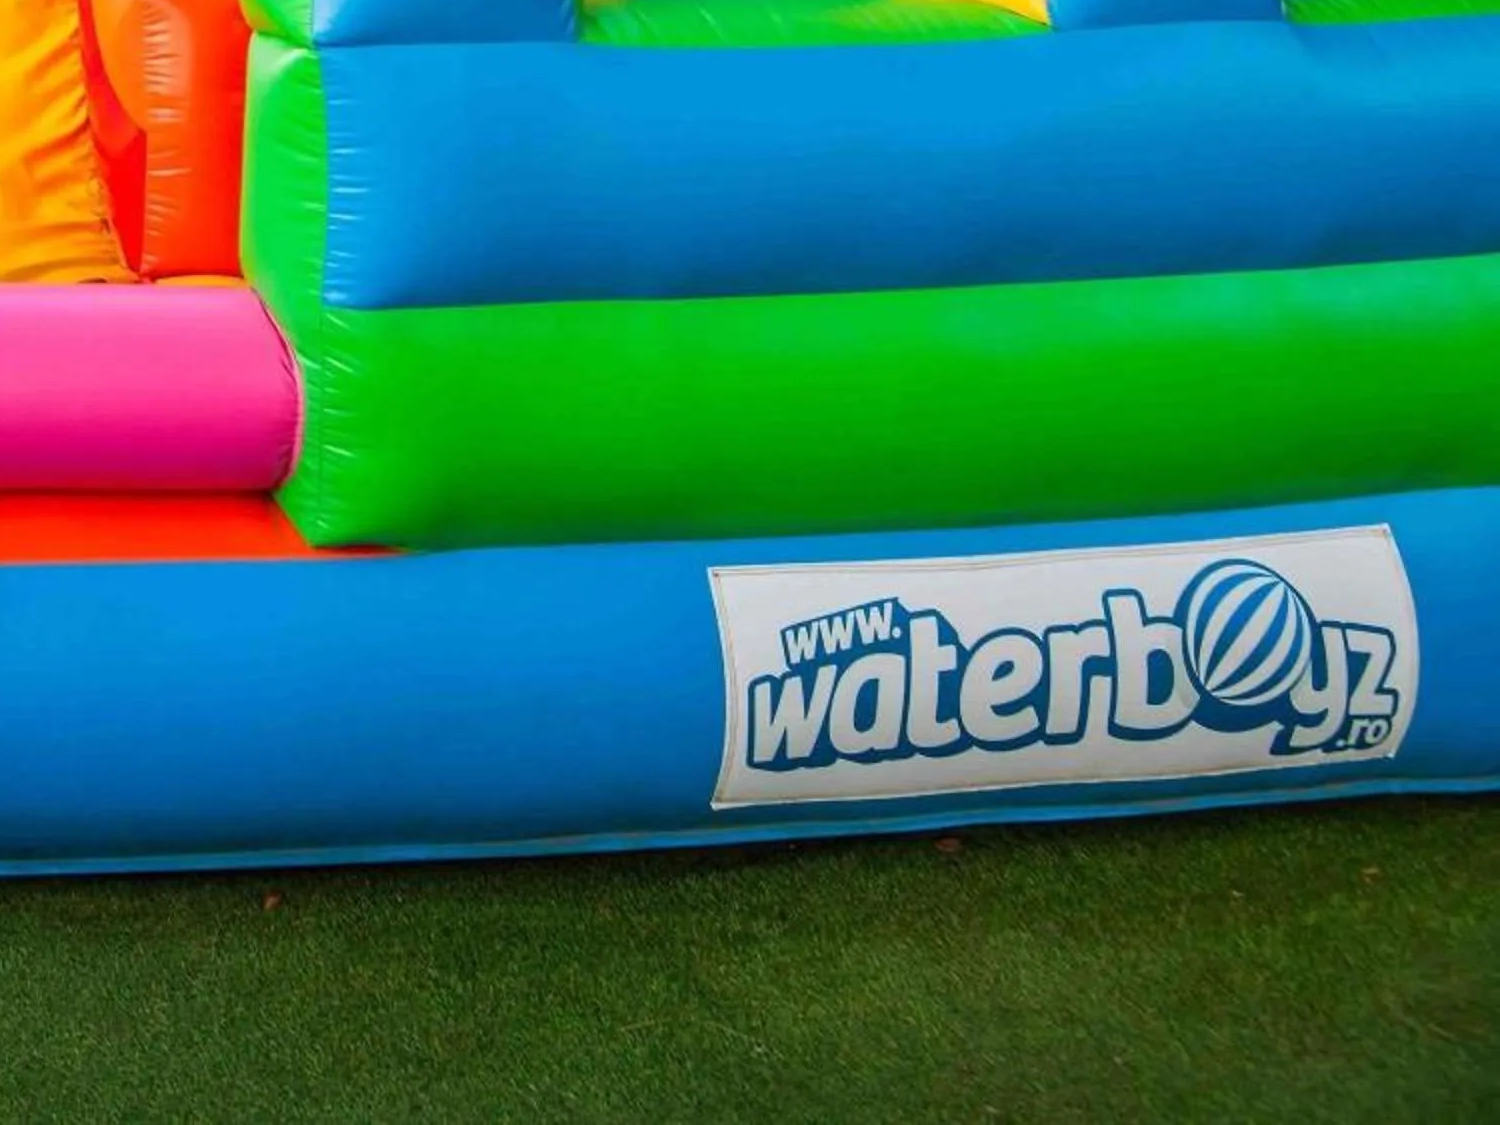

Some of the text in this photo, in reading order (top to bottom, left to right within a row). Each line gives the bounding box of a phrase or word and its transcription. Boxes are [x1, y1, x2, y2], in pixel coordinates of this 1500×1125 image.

[748, 559, 1397, 769] waterboyz
[782, 599, 903, 666] www.
[1336, 715, 1392, 750] .ro
